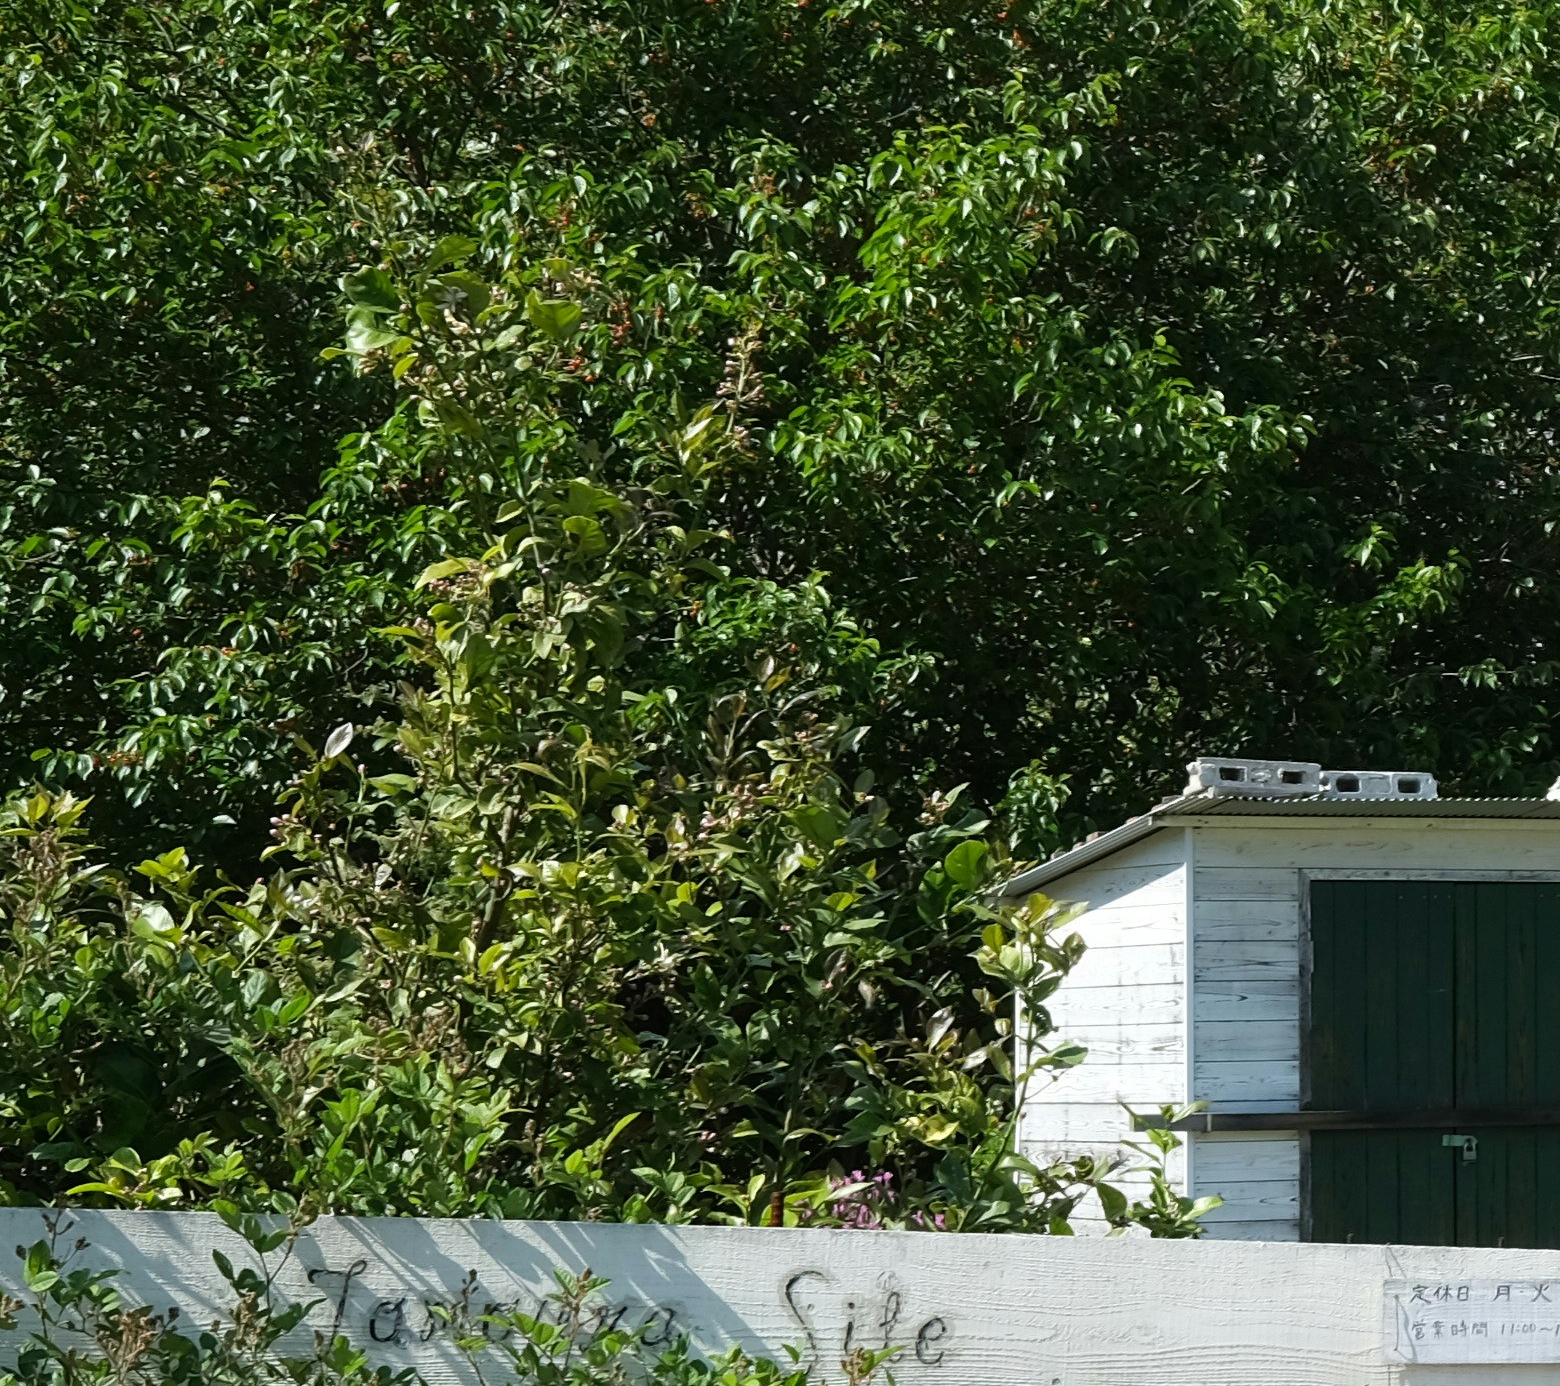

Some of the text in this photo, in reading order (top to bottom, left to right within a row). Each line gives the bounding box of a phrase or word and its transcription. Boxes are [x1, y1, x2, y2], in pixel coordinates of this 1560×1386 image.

[1409, 1284, 1470, 1304] 定休日
[785, 1269, 947, 1377] Site
[1411, 1319, 1488, 1340] 営業時間
